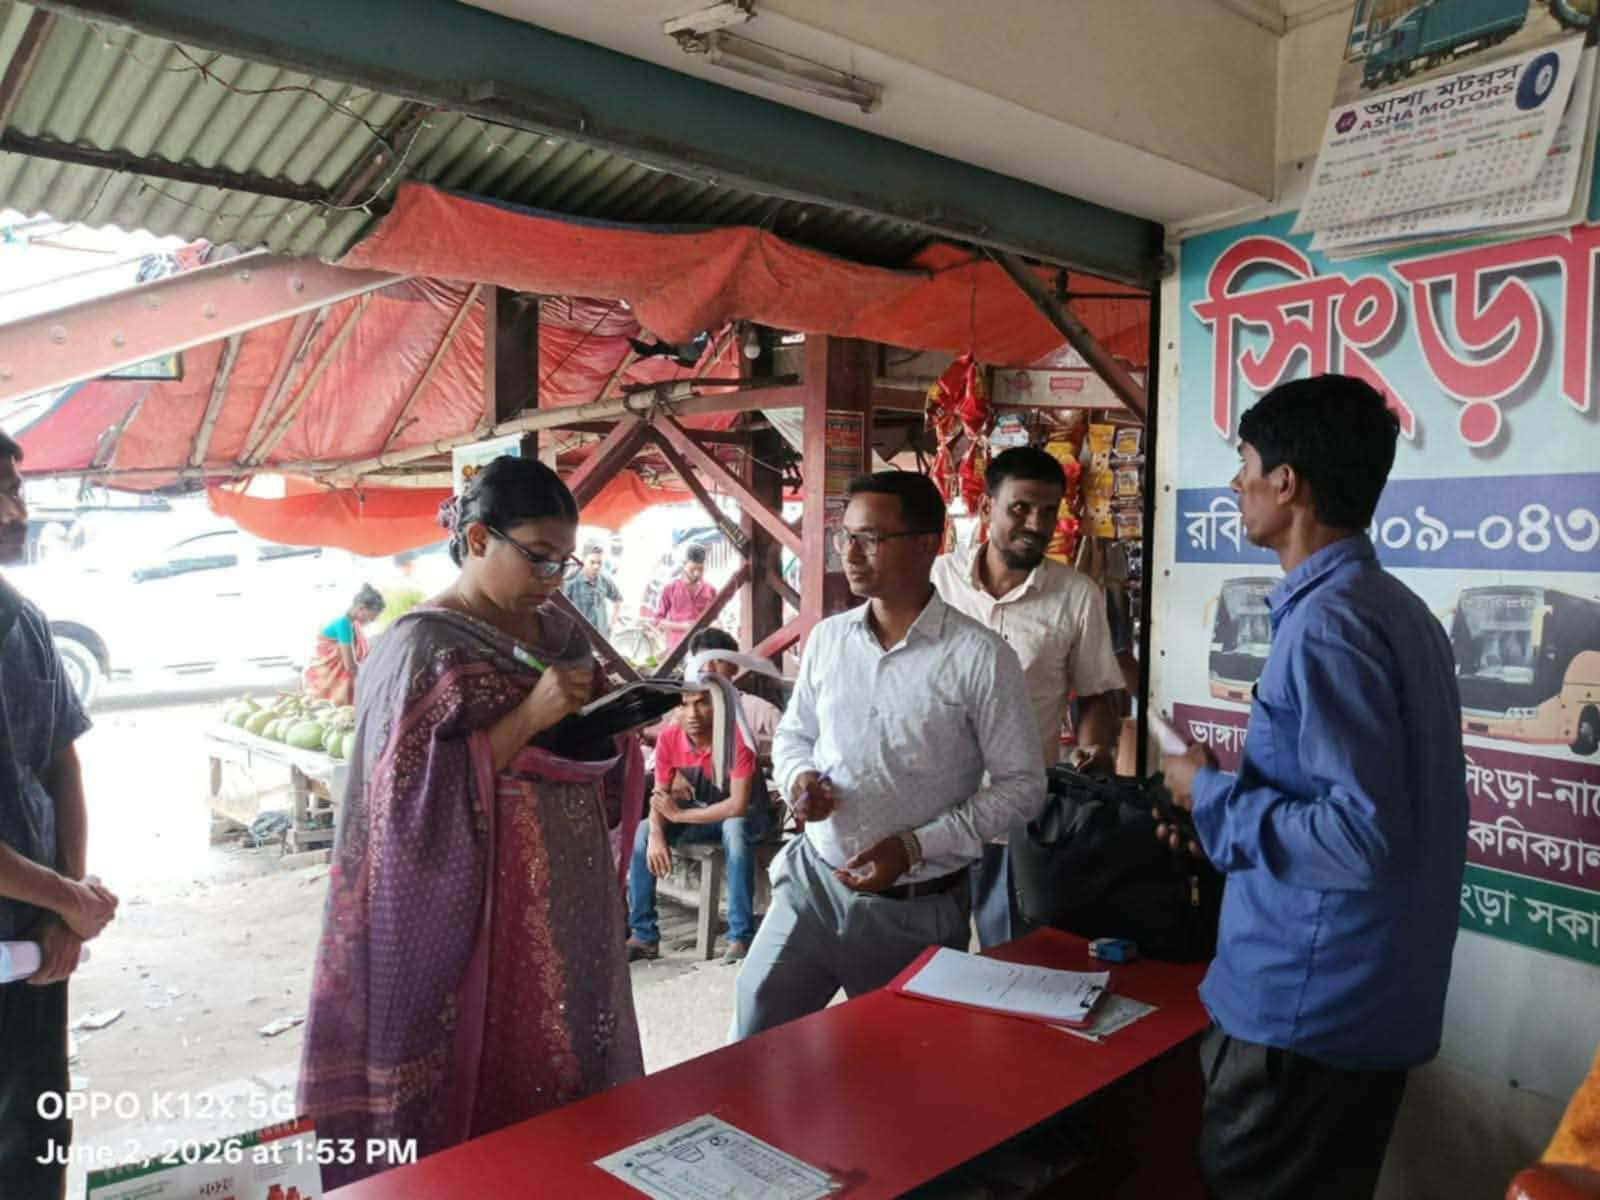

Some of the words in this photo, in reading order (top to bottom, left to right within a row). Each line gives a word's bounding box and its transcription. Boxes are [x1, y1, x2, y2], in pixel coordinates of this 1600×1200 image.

[1360, 111, 1413, 131] ASHA
[1419, 81, 1515, 116] MOTORS
[1364, 90, 1428, 115] আশা
[1437, 63, 1523, 96] মটরস
[1366, 503, 1600, 553] ০৯-০৪৩
